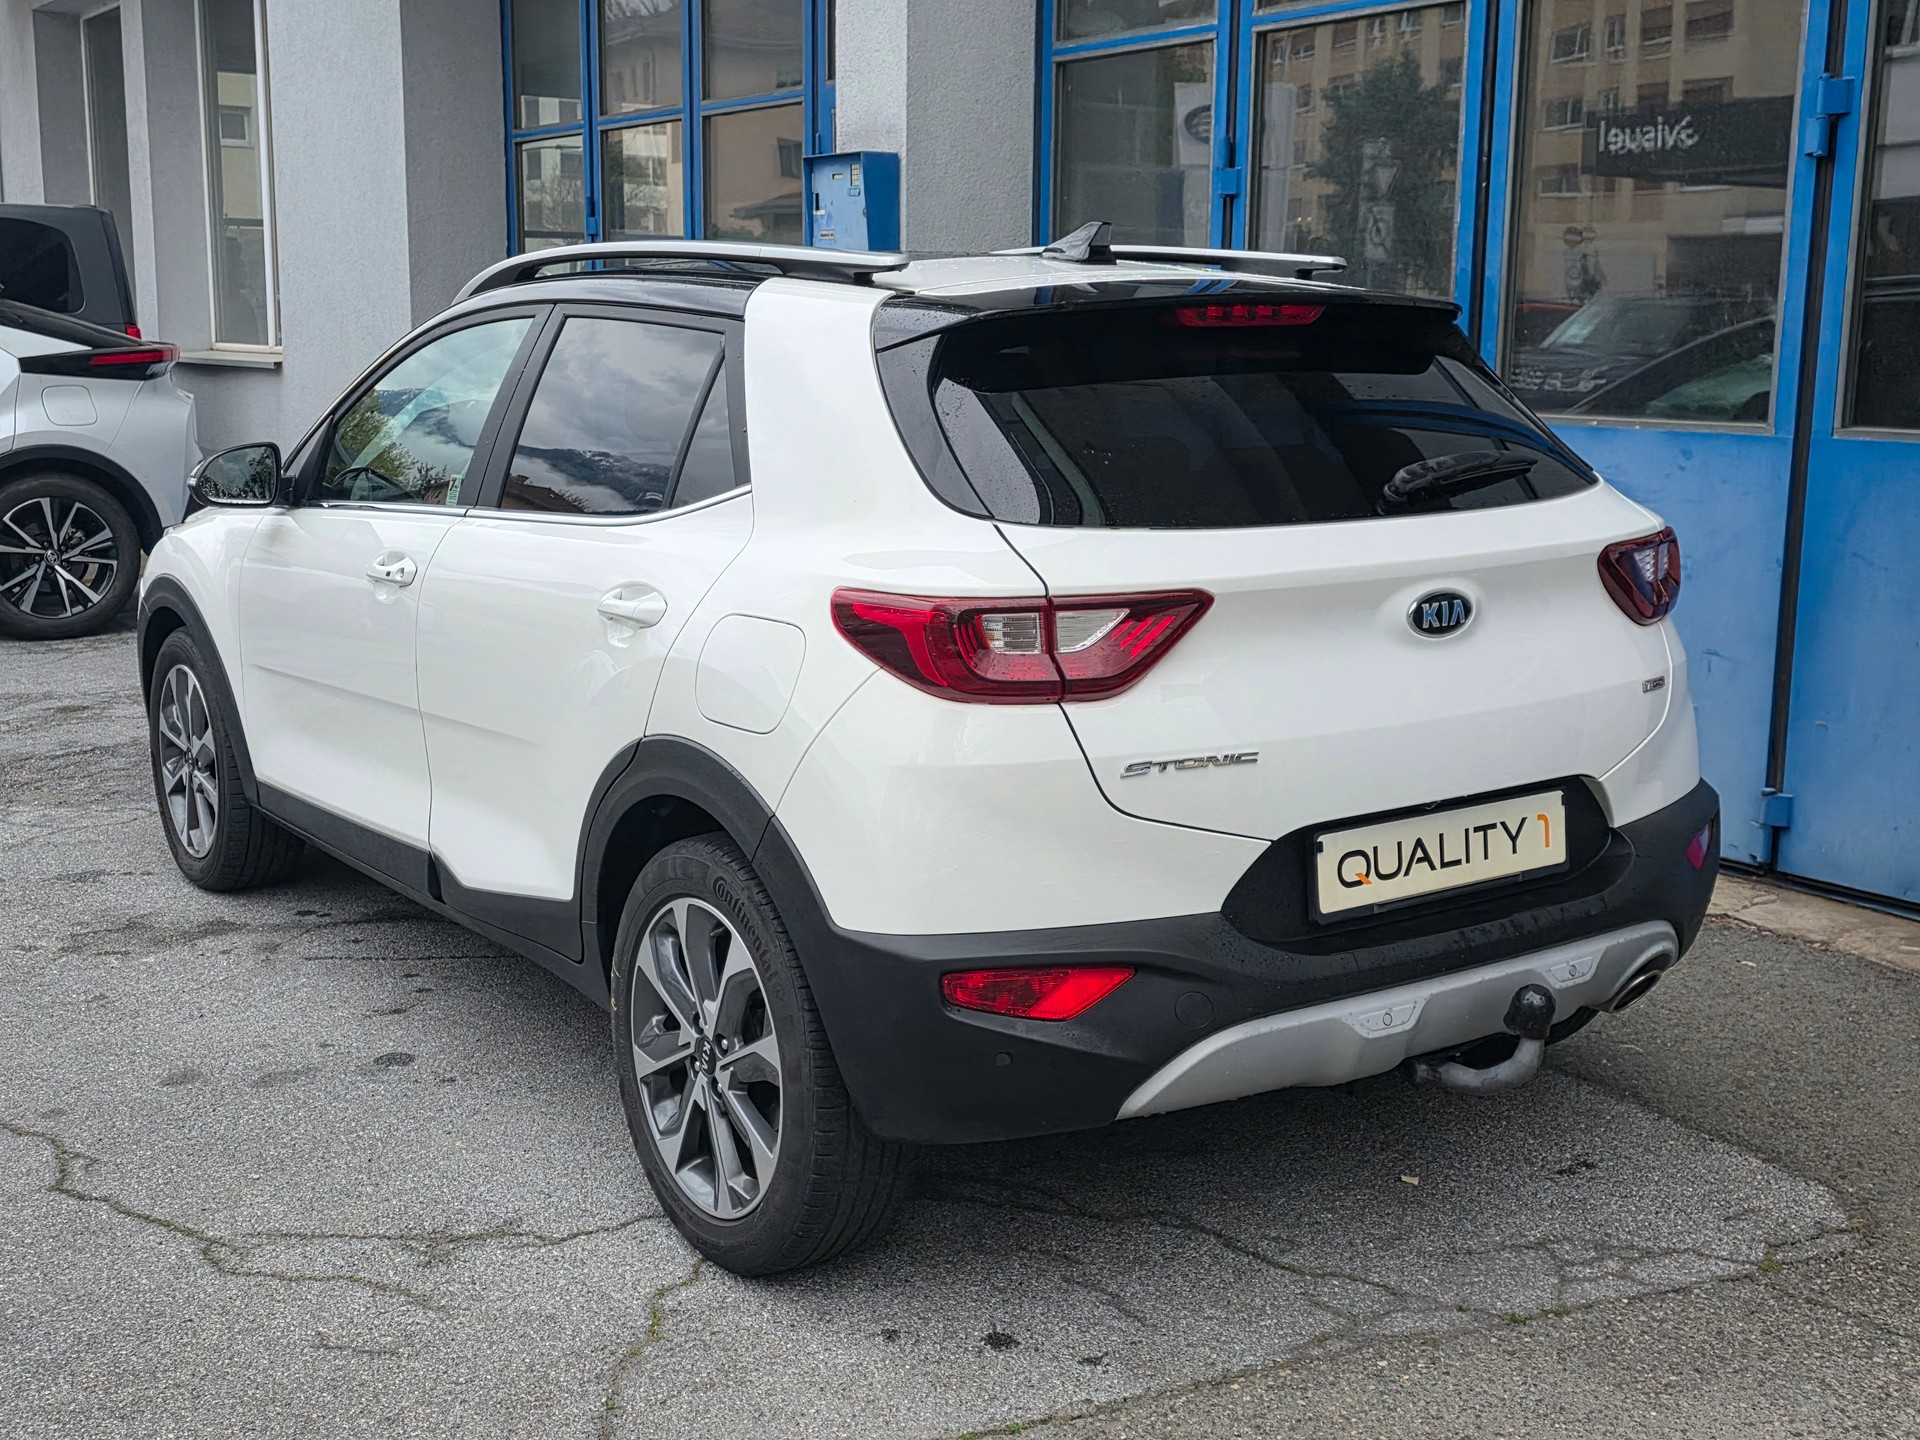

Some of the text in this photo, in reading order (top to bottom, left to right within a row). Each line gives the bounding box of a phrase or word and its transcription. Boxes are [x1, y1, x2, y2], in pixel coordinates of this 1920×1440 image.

[1421, 599, 1466, 629] KIA
[1119, 751, 1260, 779] STONIC
[712, 875, 779, 983] Continental
[701, 1040, 711, 1070] KIA
